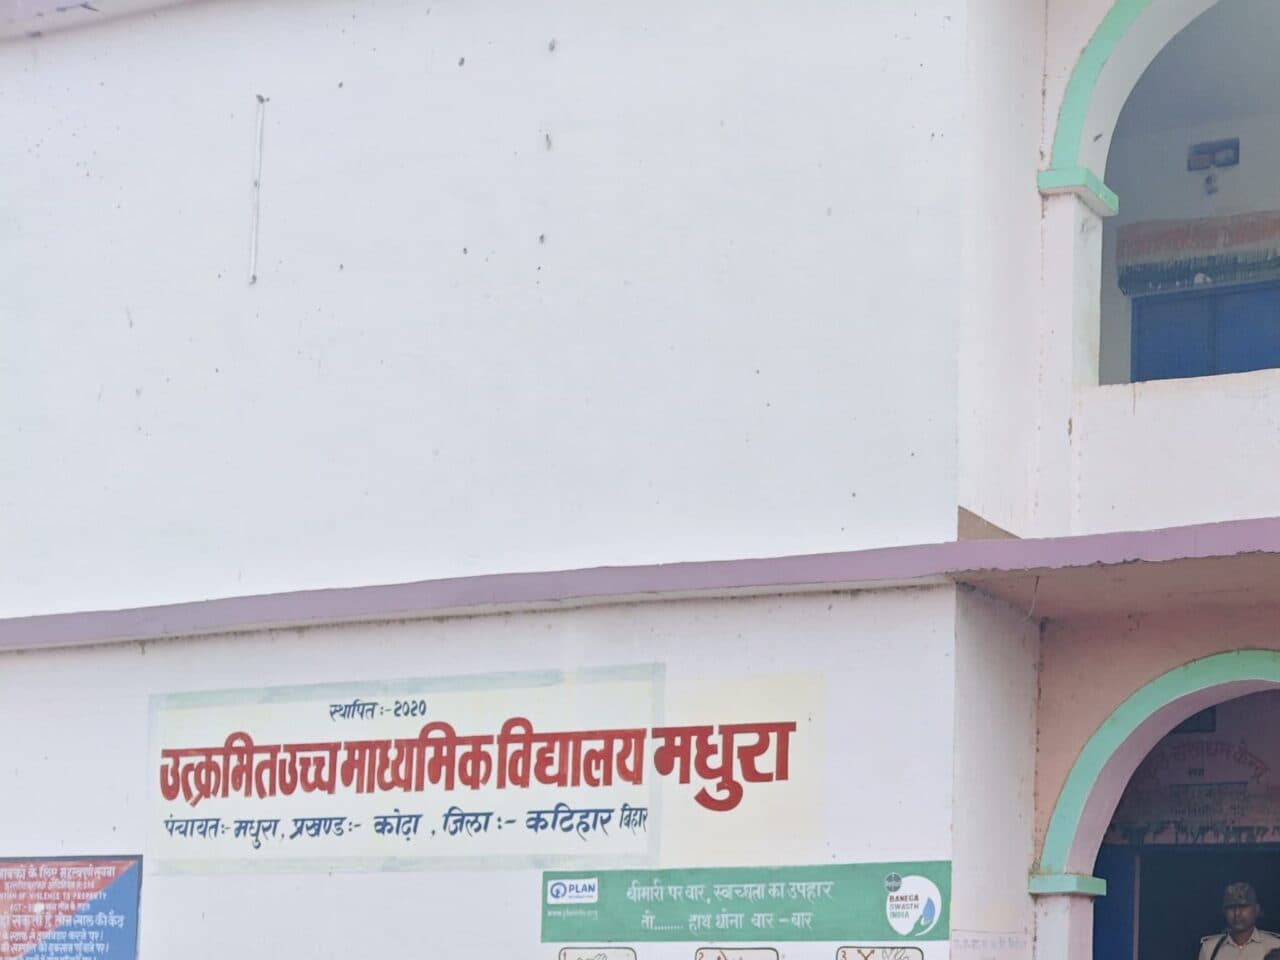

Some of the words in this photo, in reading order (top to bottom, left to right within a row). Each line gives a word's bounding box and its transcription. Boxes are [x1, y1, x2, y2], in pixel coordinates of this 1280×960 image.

[341, 721, 494, 794] माध्यमिक
[496, 717, 648, 789] विद्यालय
[651, 721, 797, 812] मधुरा
[525, 802, 614, 841] कटिहार
[619, 802, 648, 833] बिहार
[568, 883, 596, 894] PLAN
[768, 882, 785, 899] का
[787, 881, 835, 904] उपहार
